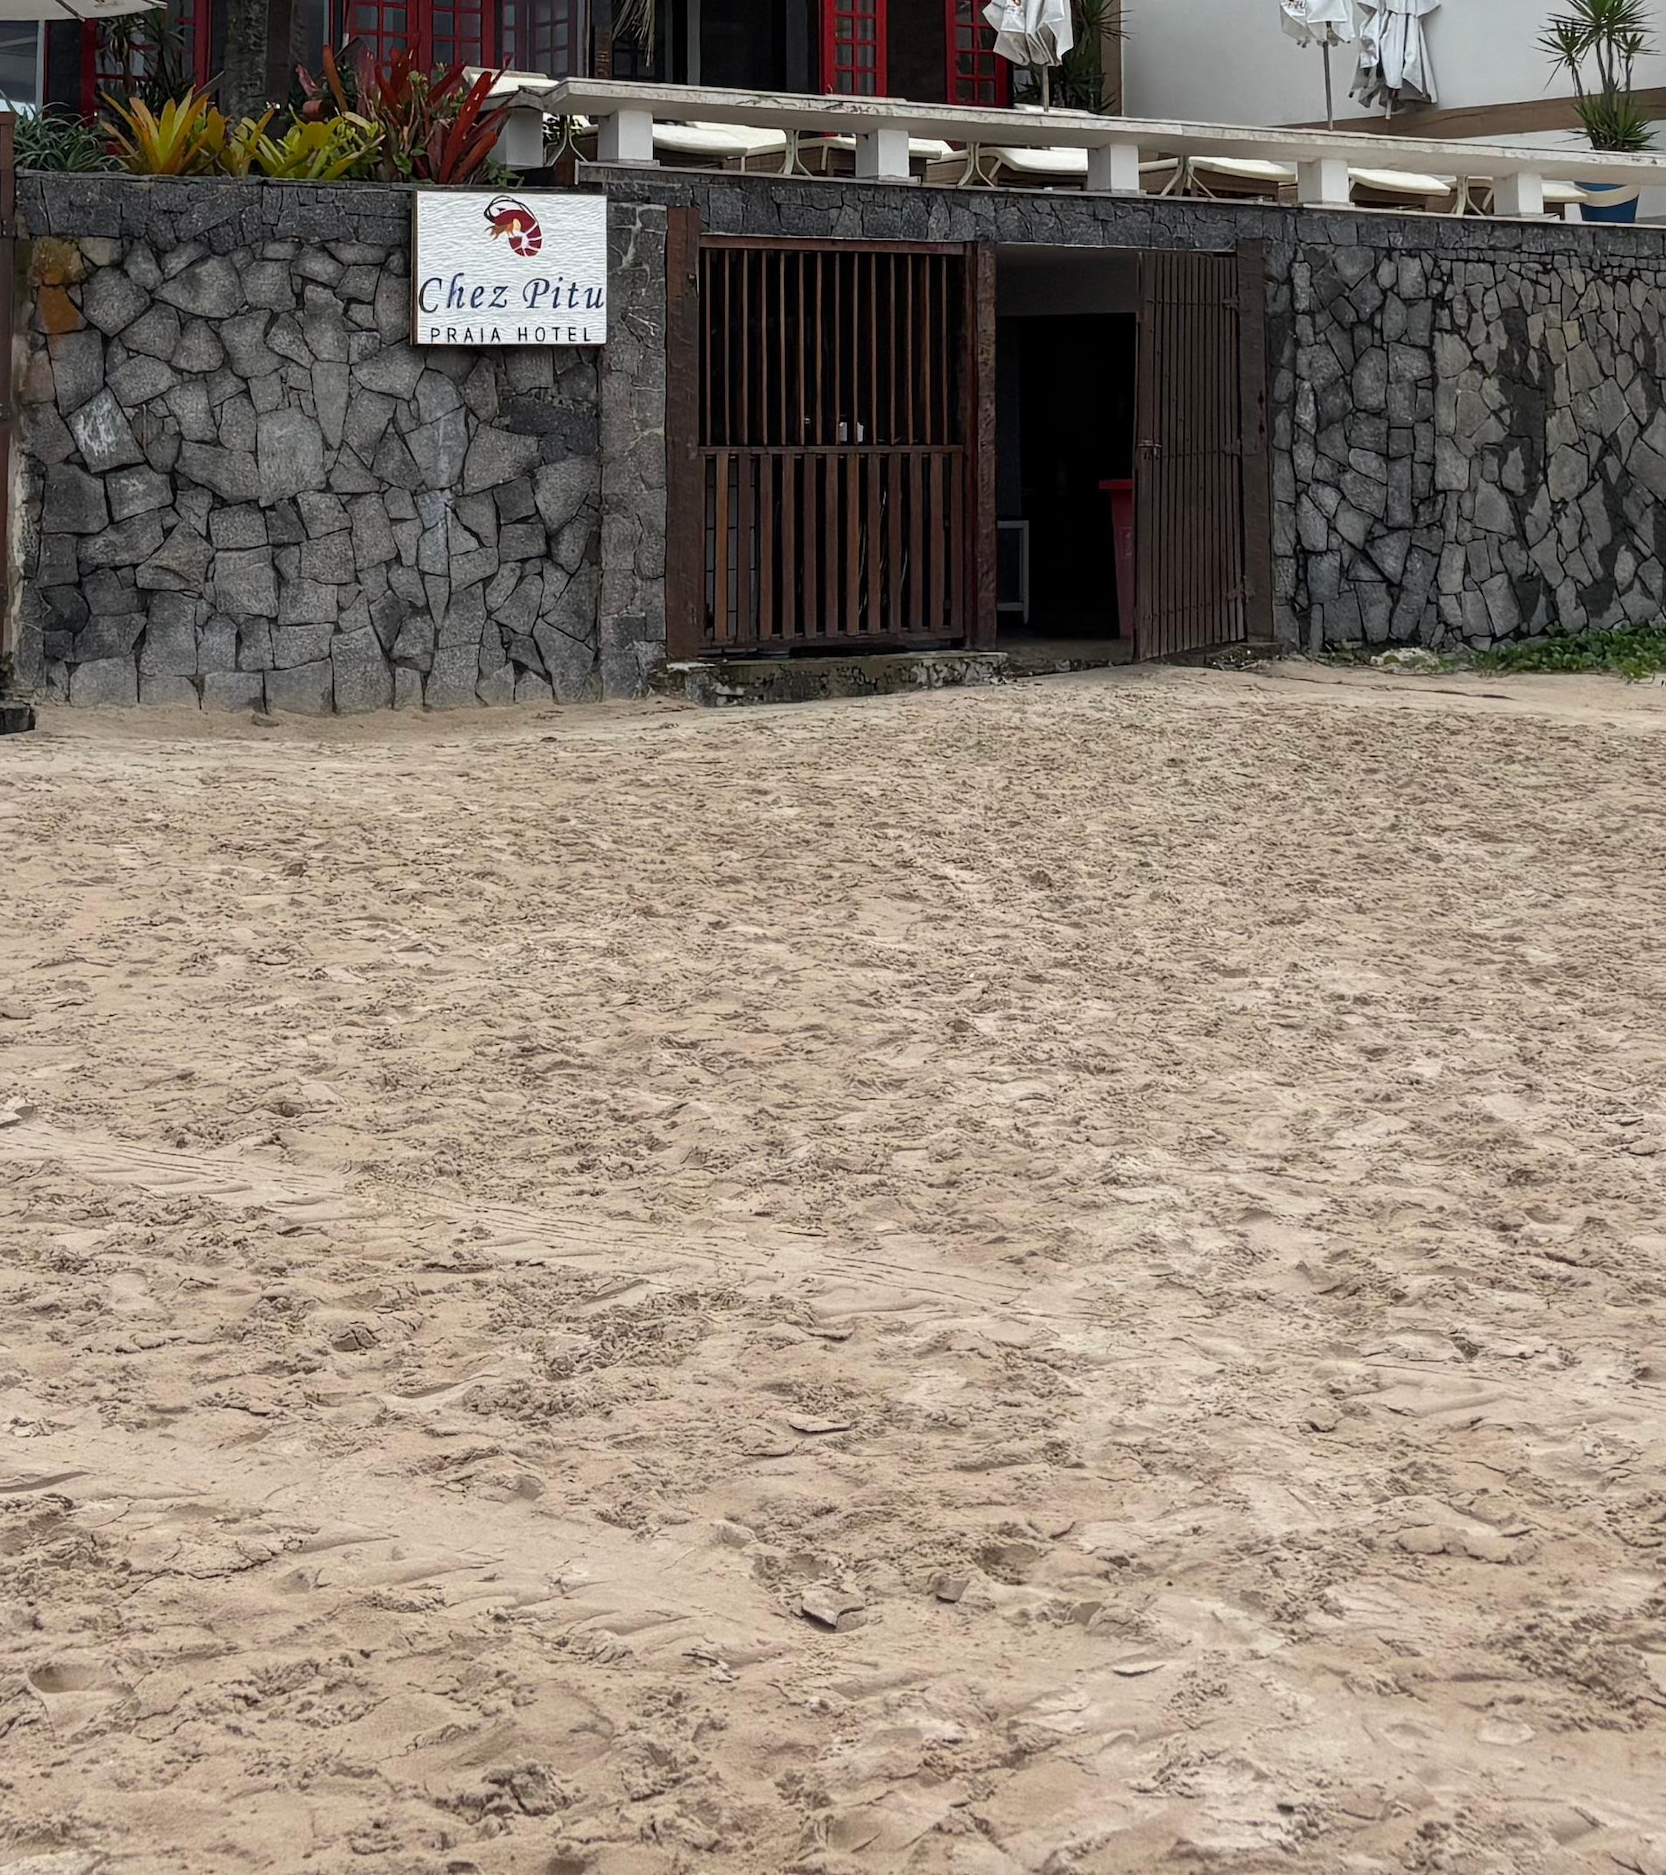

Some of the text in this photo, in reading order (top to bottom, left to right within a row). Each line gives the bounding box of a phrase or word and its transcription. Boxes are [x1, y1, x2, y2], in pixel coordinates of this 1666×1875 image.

[418, 272, 604, 313] Chez Pitu
[430, 327, 592, 342] PRAIA HOTEL
